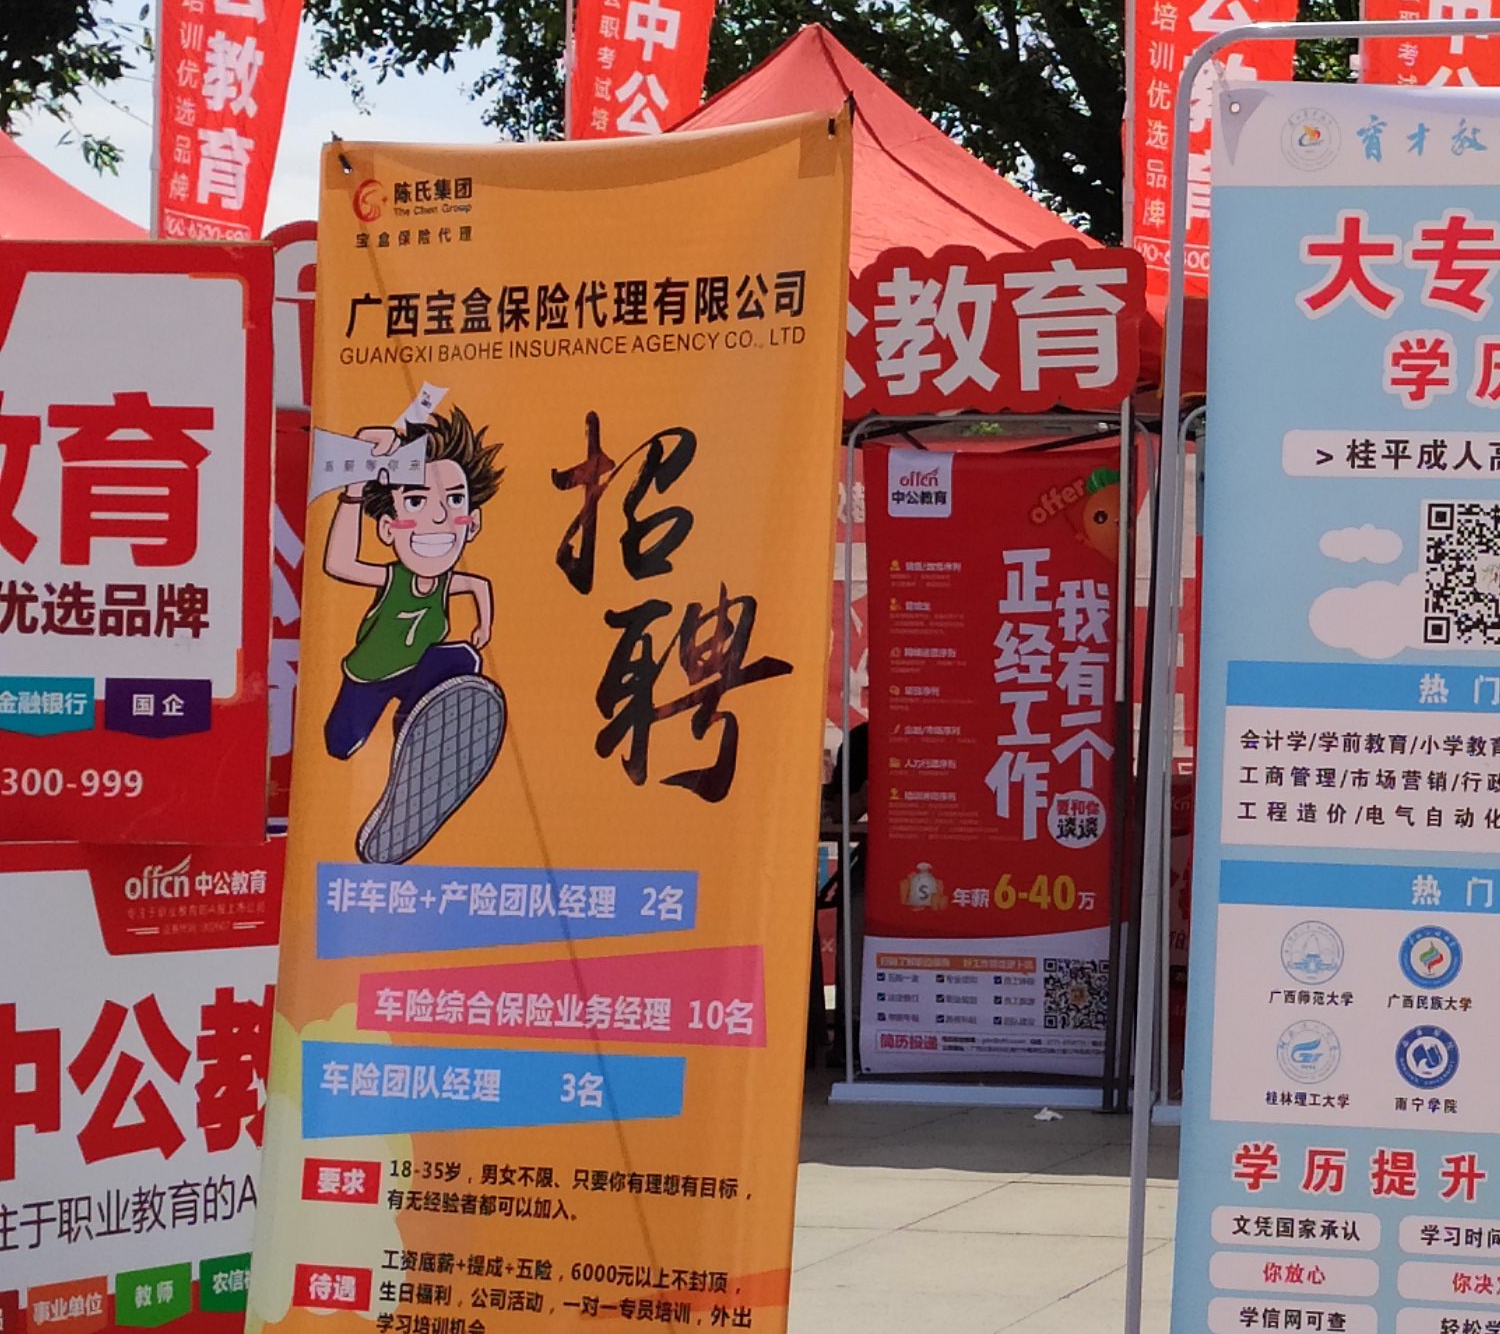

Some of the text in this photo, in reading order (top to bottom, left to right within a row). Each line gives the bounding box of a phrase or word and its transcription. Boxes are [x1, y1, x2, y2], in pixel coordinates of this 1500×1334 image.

[394, 177, 473, 204] 陈氏集团
[355, 225, 473, 249] 宝盒保险代理
[345, 269, 807, 339] 广西宝盒保险代理有限公司
[340, 344, 434, 365] GUANGXI
[438, 341, 504, 363] BAOHE
[508, 336, 627, 359] INSURANCE
[631, 331, 720, 355] AGENCY
[769, 326, 807, 348] LTD
[0, 391, 215, 568] 育
[891, 490, 948, 506] 中公教育
[1030, 478, 1087, 525] offer
[551, 410, 795, 804] 招聘
[984, 547, 1054, 841] 正经工作
[1051, 578, 1116, 789] 我有一个
[0, 691, 88, 717] 金融银行
[131, 693, 185, 718] 国企
[1056, 818, 1099, 840] 谈谈
[125, 854, 268, 901] offcn 中公教育
[325, 877, 685, 924] 非车险+产险团队经理 2名
[375, 987, 755, 1037] 车险综合保险业务经理 10名
[1268, 989, 1354, 1007] 广西师范大学
[1387, 993, 1473, 1012] 广西民族大学
[319, 1059, 604, 1109] 车险团队经理 3名
[1265, 1090, 1351, 1109] 桂林理工大学
[1394, 1096, 1458, 1115] 南宁学院
[316, 1167, 367, 1196] 要求
[387, 1189, 580, 1223] 有无经验者都可以加入。
[1231, 1214, 1362, 1243] 文凭国家承认
[308, 1273, 358, 1303] 待遇
[1262, 1261, 1327, 1287] 你放心
[32, 1291, 103, 1327] 事业单位
[135, 1280, 174, 1309] 教师
[1239, 1306, 1348, 1334] 学信网可查
